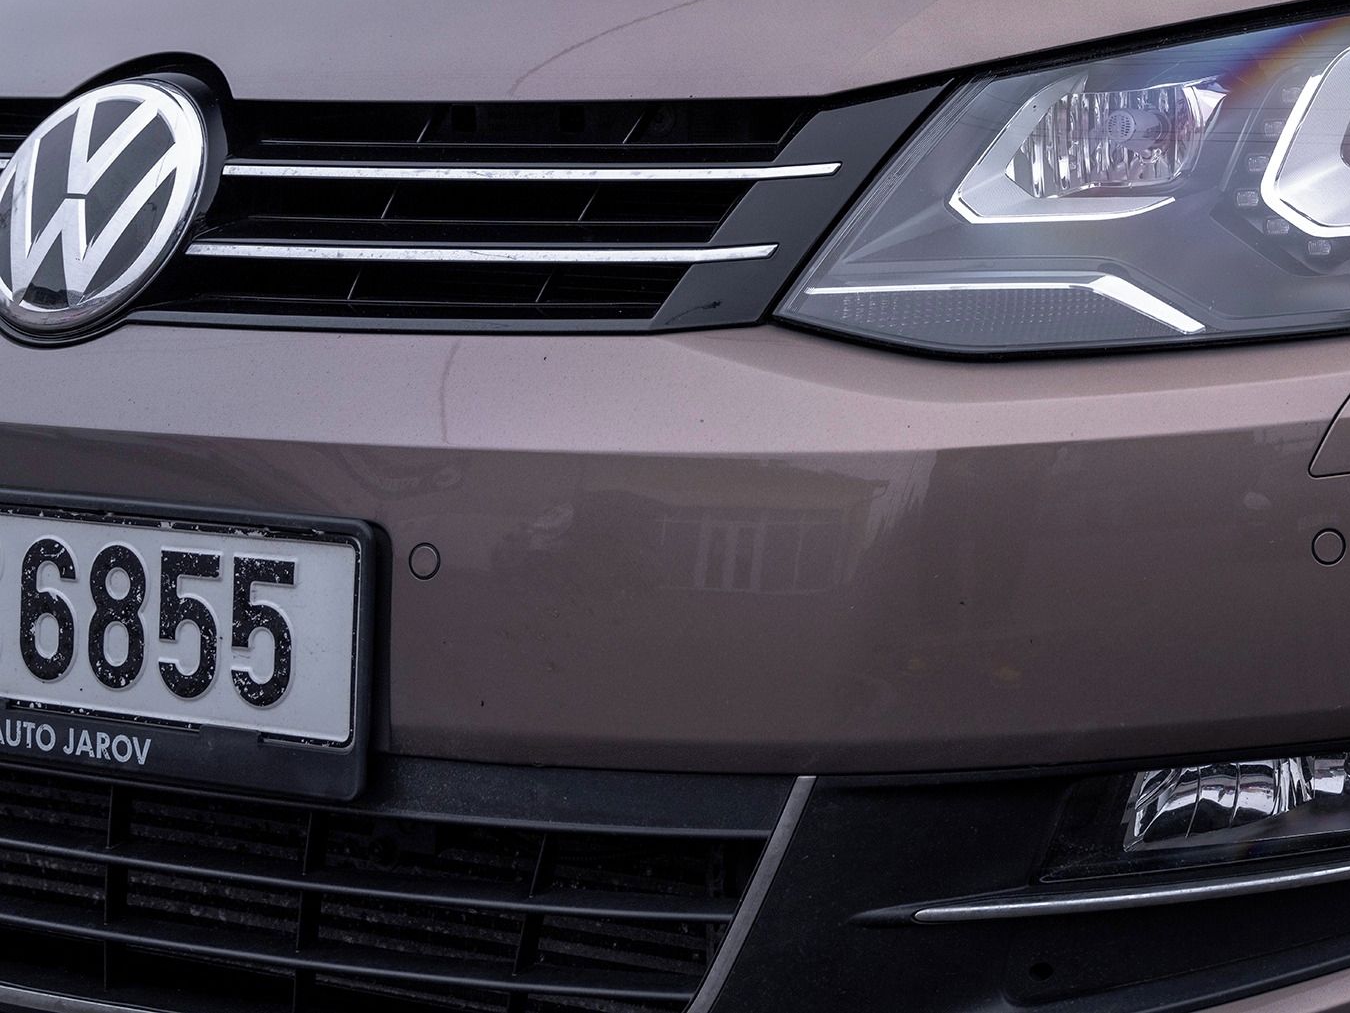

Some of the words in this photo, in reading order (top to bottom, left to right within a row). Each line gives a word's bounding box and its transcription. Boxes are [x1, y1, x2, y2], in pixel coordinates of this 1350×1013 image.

[20, 536, 296, 708] 6855
[0, 719, 56, 752] UTO
[62, 727, 152, 765] JAROV
